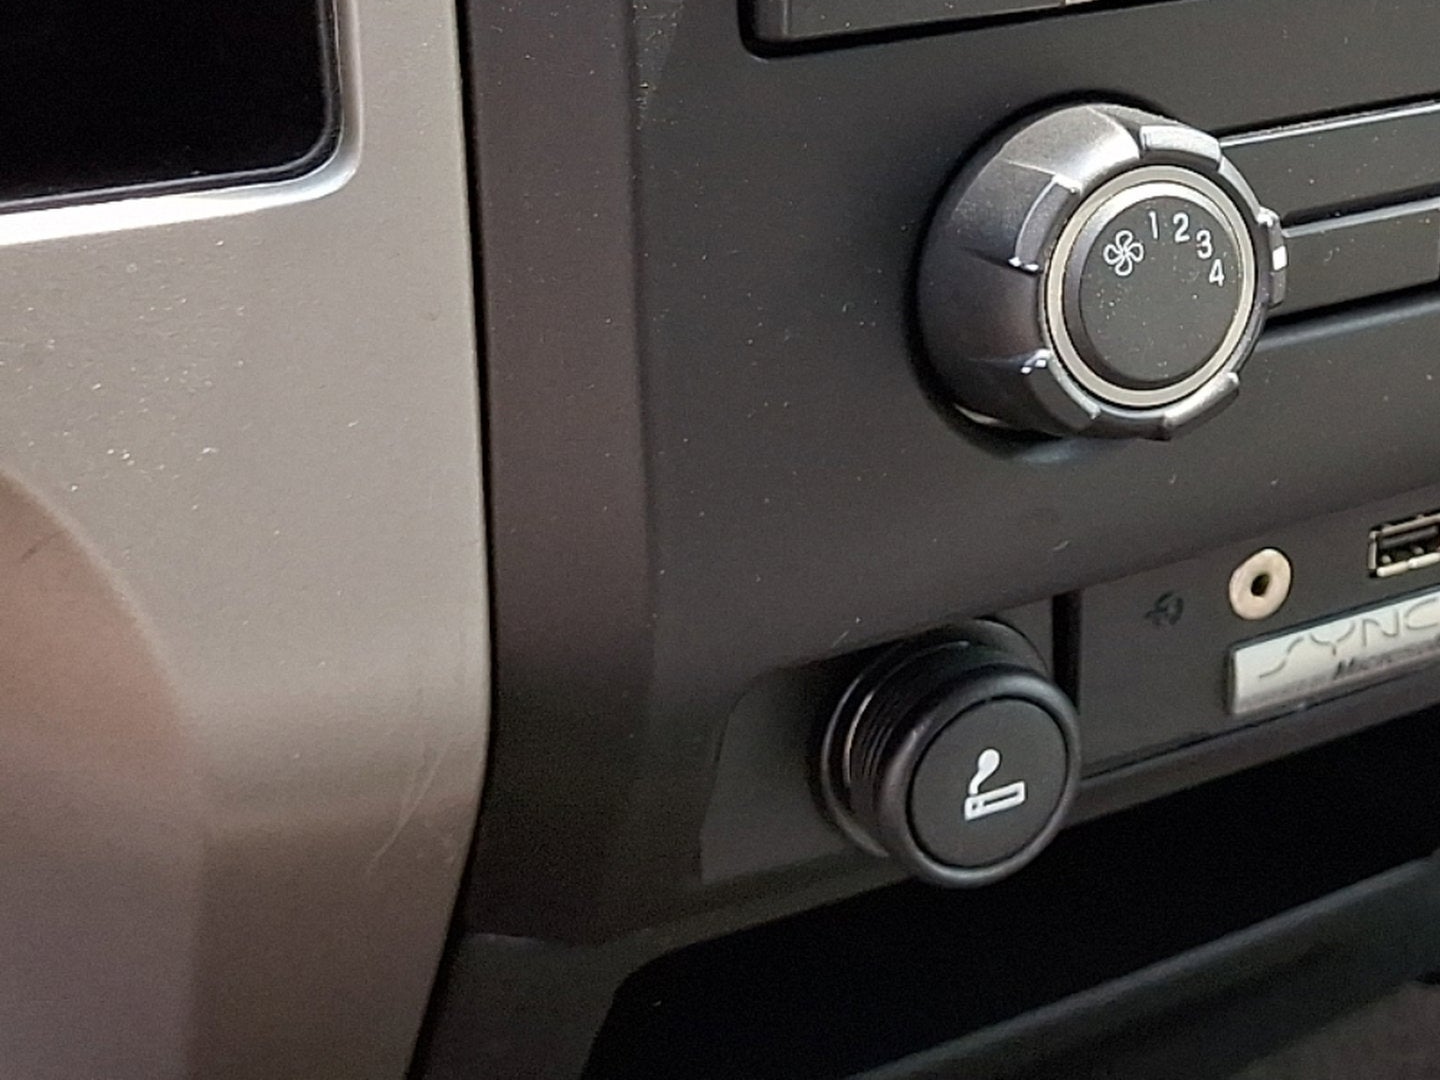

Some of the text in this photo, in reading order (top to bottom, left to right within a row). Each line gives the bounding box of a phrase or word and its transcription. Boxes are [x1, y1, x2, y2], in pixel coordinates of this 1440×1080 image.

[1148, 211, 1225, 286] 1 2 3 4
[1258, 597, 1440, 680] SYNC
